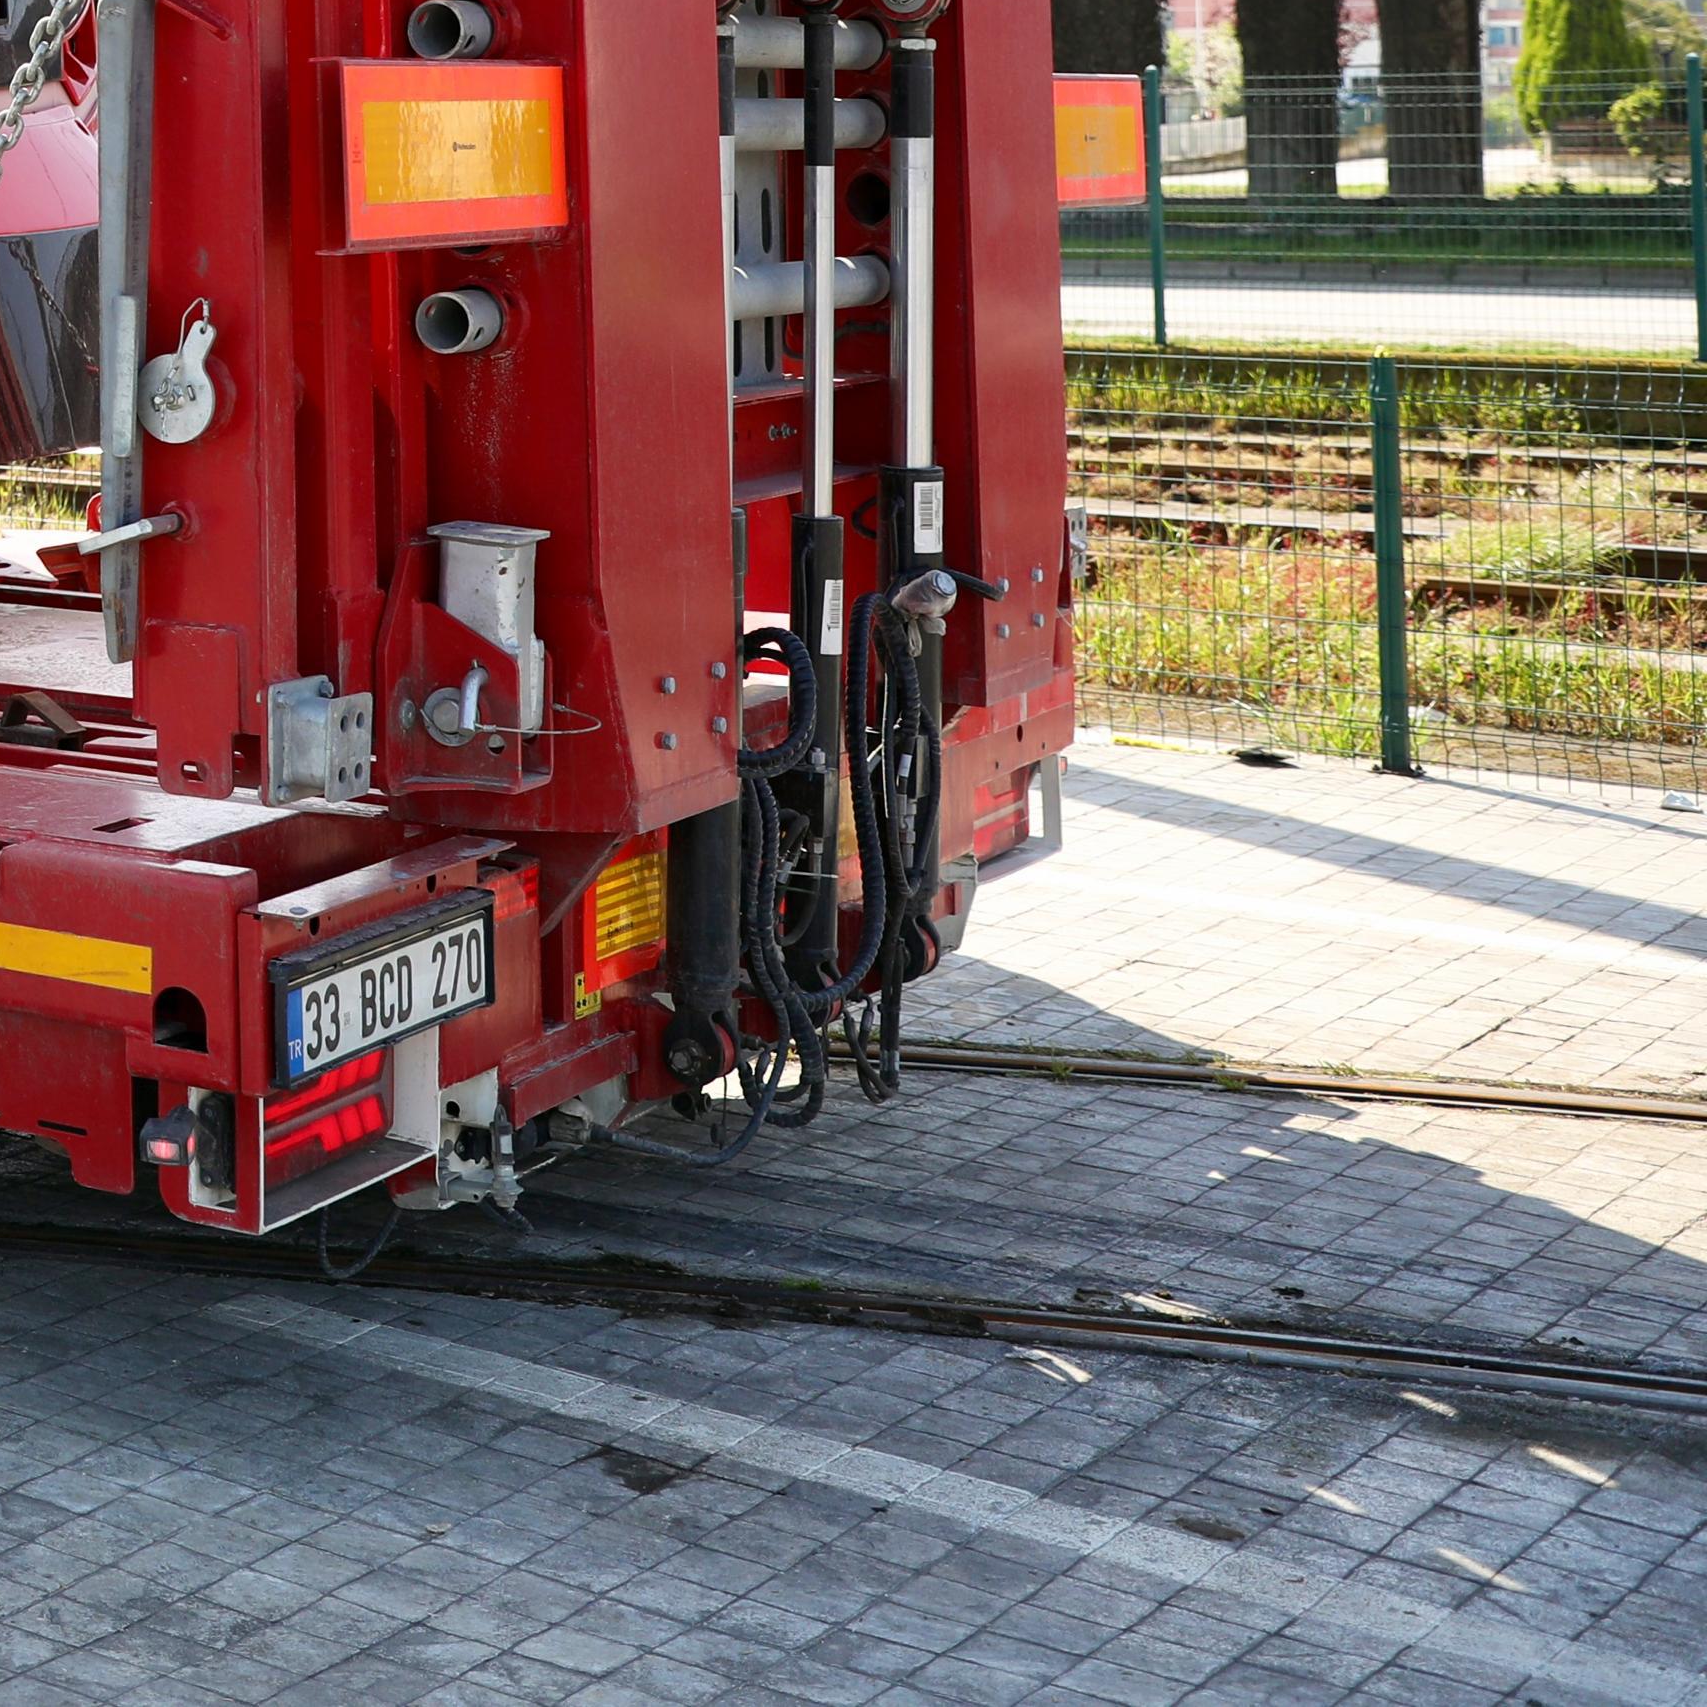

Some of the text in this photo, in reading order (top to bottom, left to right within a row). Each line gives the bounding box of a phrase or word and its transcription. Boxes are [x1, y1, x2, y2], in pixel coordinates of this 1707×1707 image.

[288, 927, 483, 1061] TR 33 BCD 270
